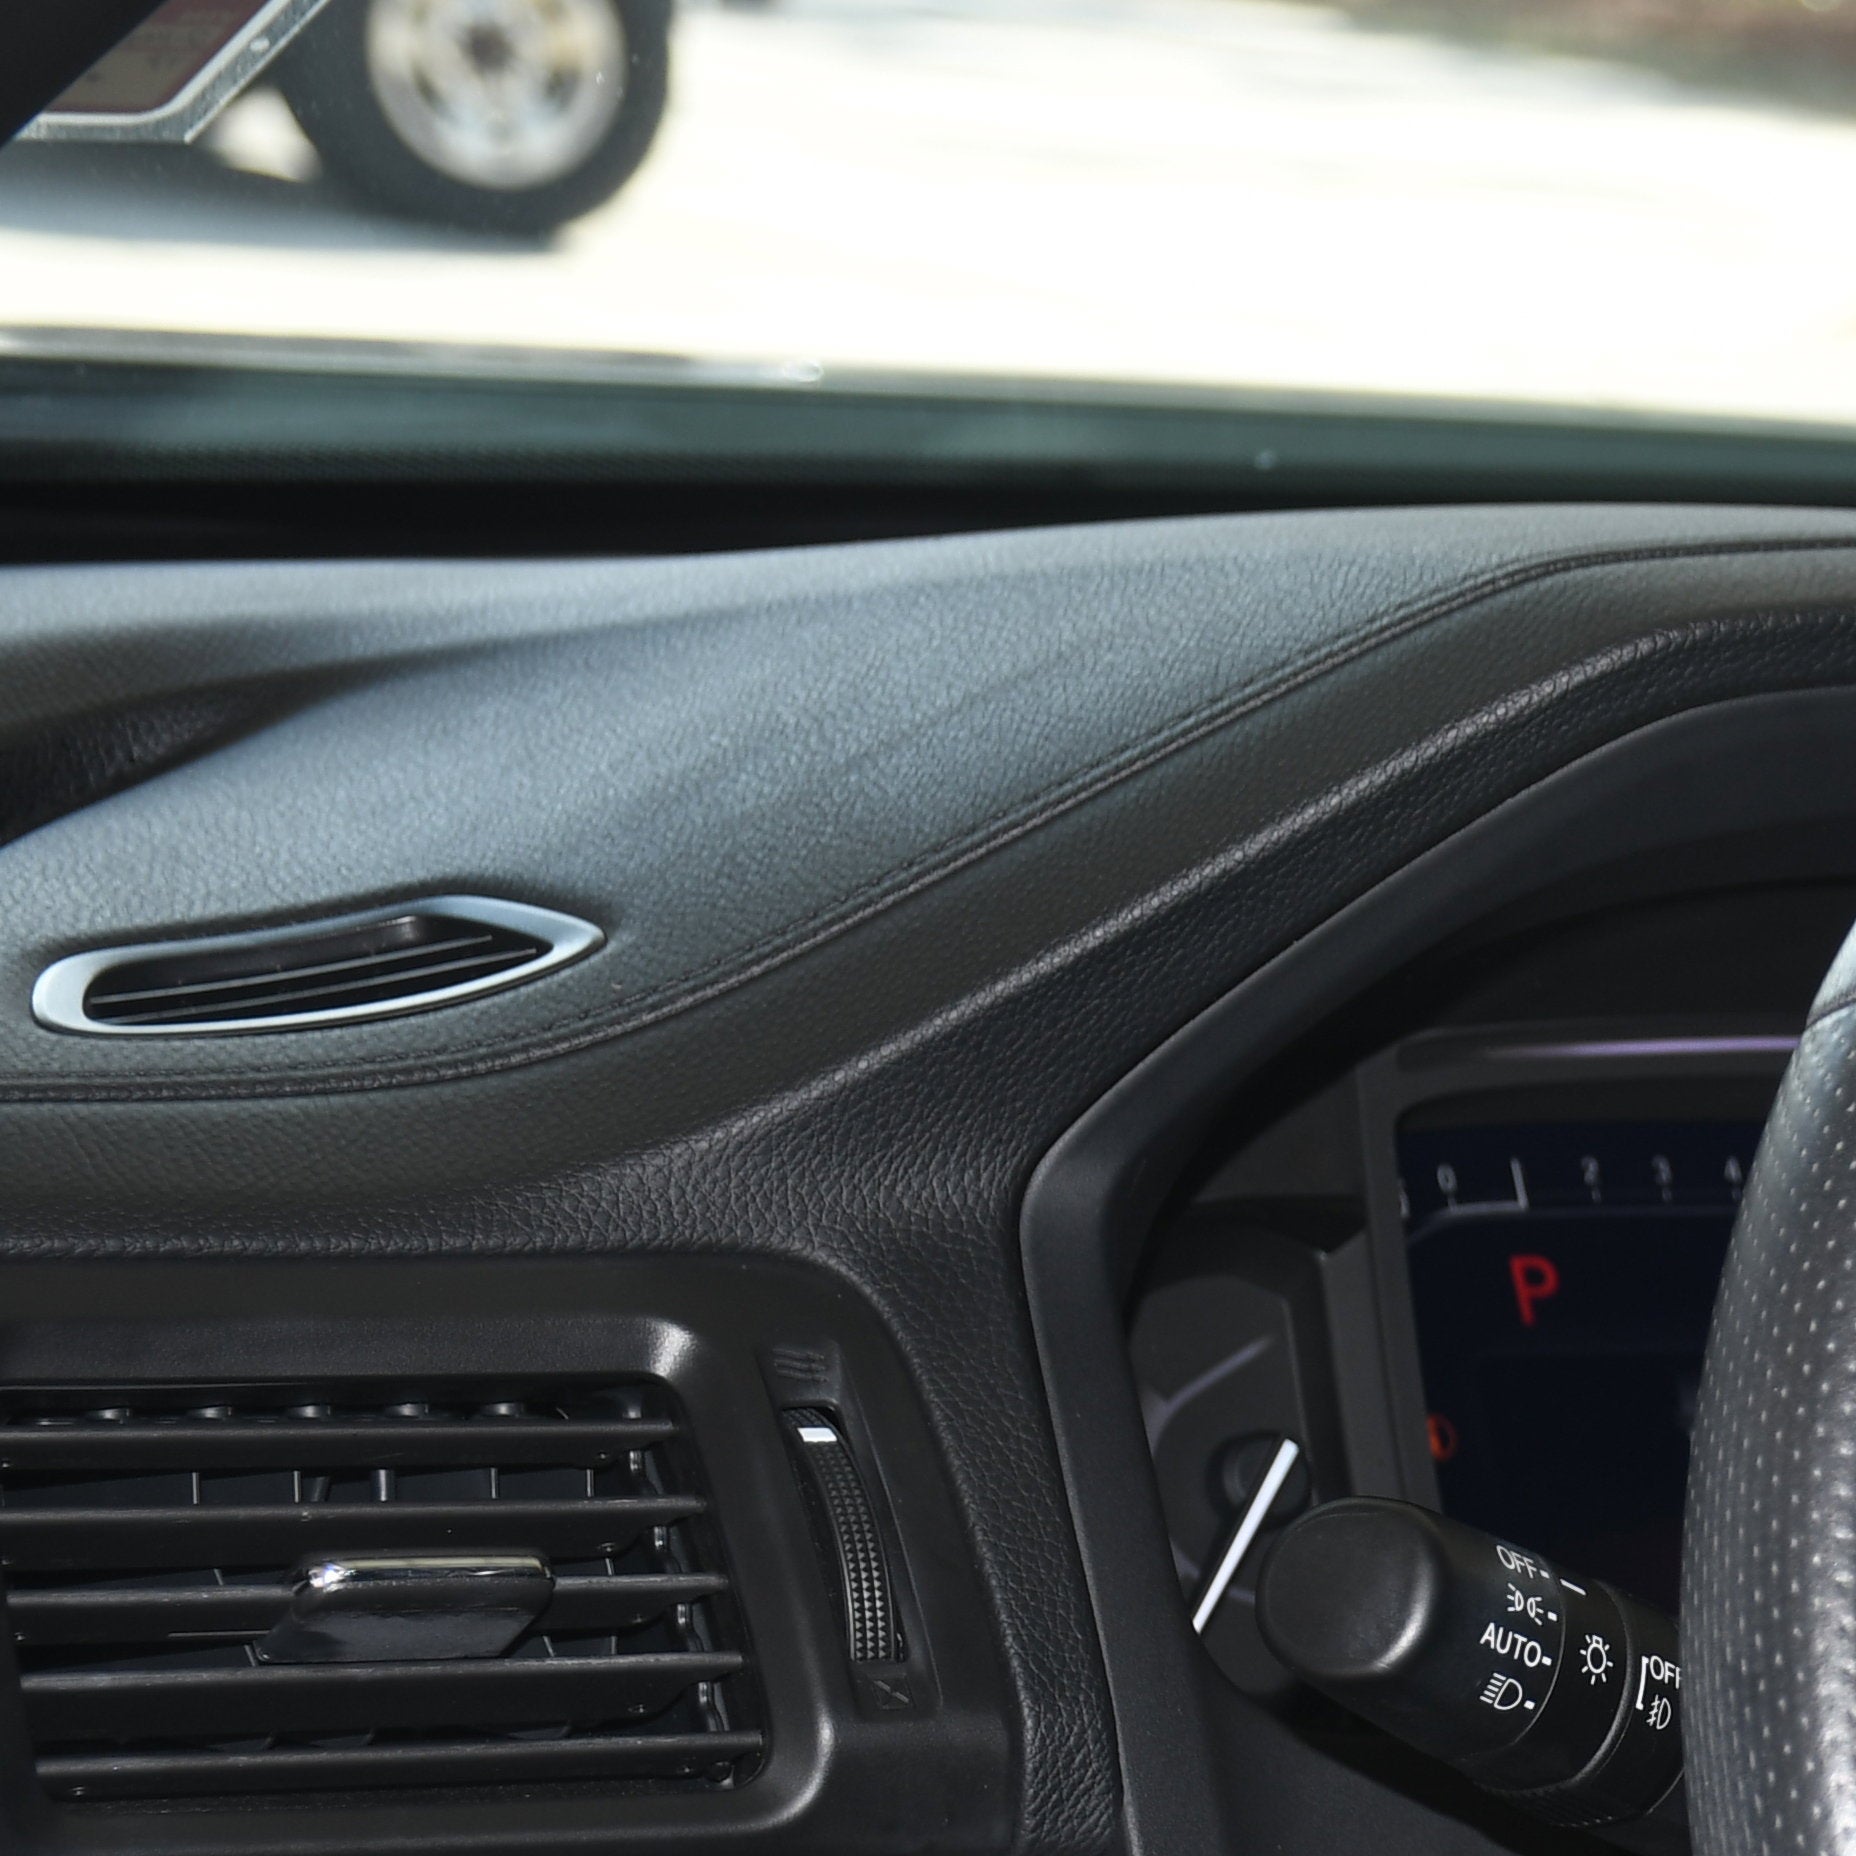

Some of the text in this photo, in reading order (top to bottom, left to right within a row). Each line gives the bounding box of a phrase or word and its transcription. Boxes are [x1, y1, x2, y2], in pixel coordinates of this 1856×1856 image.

[1508, 1254, 1561, 1327] P
[1495, 1544, 1538, 1579] OFF
[1479, 1621, 1543, 1668] AUTO
[1649, 1655, 1682, 1690] OFF
